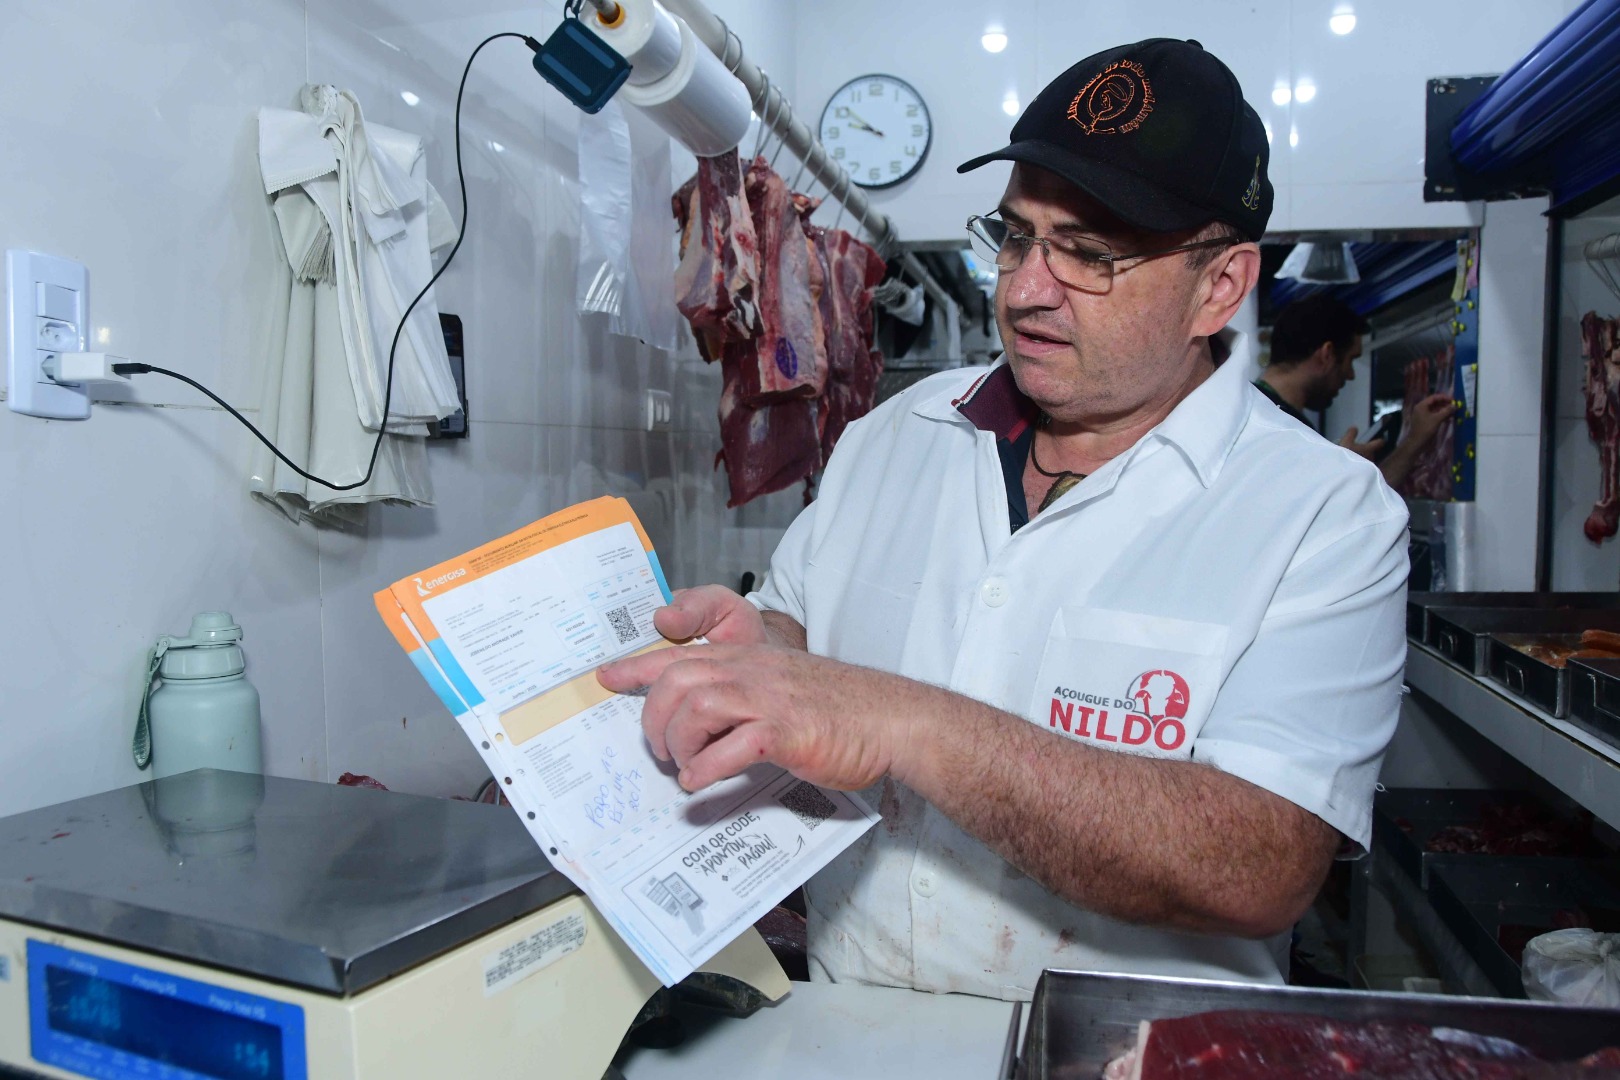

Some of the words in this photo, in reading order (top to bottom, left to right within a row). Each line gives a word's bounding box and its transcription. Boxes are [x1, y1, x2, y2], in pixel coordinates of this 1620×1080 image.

[868, 83, 884, 96] 12
[851, 90, 861, 103] 11
[835, 106, 850, 119] 10
[906, 104, 918, 118] 2
[828, 126, 840, 139] 9
[911, 124, 923, 137] 3
[834, 147, 846, 160] 8
[905, 145, 916, 157] 4
[849, 161, 860, 174] 7
[889, 160, 902, 174] 5
[868, 168, 880, 181] 6
[425, 567, 467, 590] energisa
[1054, 686, 1110, 707] AÇOUGUE
[1113, 698, 1133, 710] DO
[1049, 698, 1186, 751] NILDO
[682, 843, 712, 868] COM
[708, 832, 728, 849] QR
[725, 811, 761, 837] CODE,
[737, 833, 778, 870] PAGOU!
